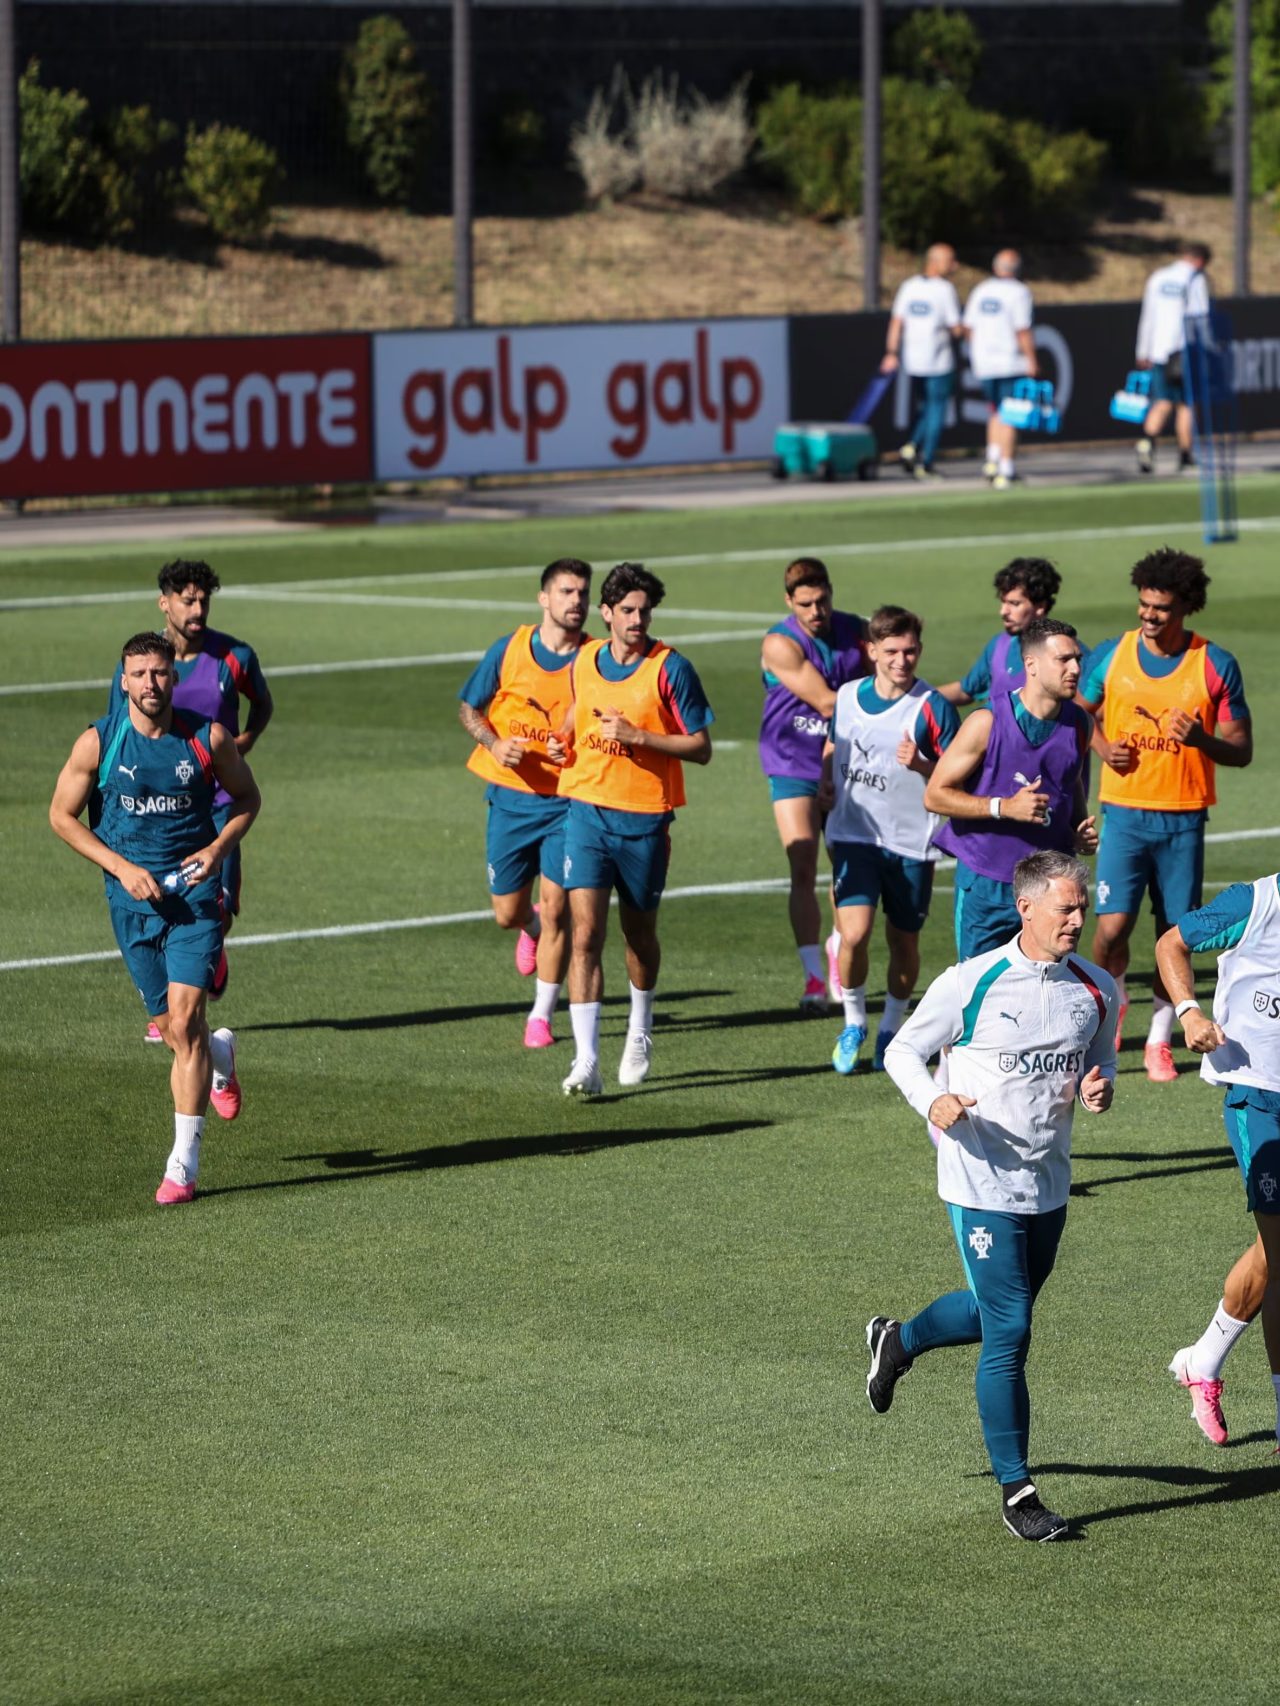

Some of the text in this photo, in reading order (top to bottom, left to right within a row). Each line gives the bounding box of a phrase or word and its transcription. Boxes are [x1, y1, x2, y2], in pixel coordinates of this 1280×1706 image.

[402, 336, 568, 469] galp
[607, 329, 761, 458] galp
[588, 734, 634, 758] SAGRES
[1131, 732, 1181, 755] SAGRES
[136, 793, 192, 815] SAGRES
[1019, 1050, 1083, 1075] SAGRES
